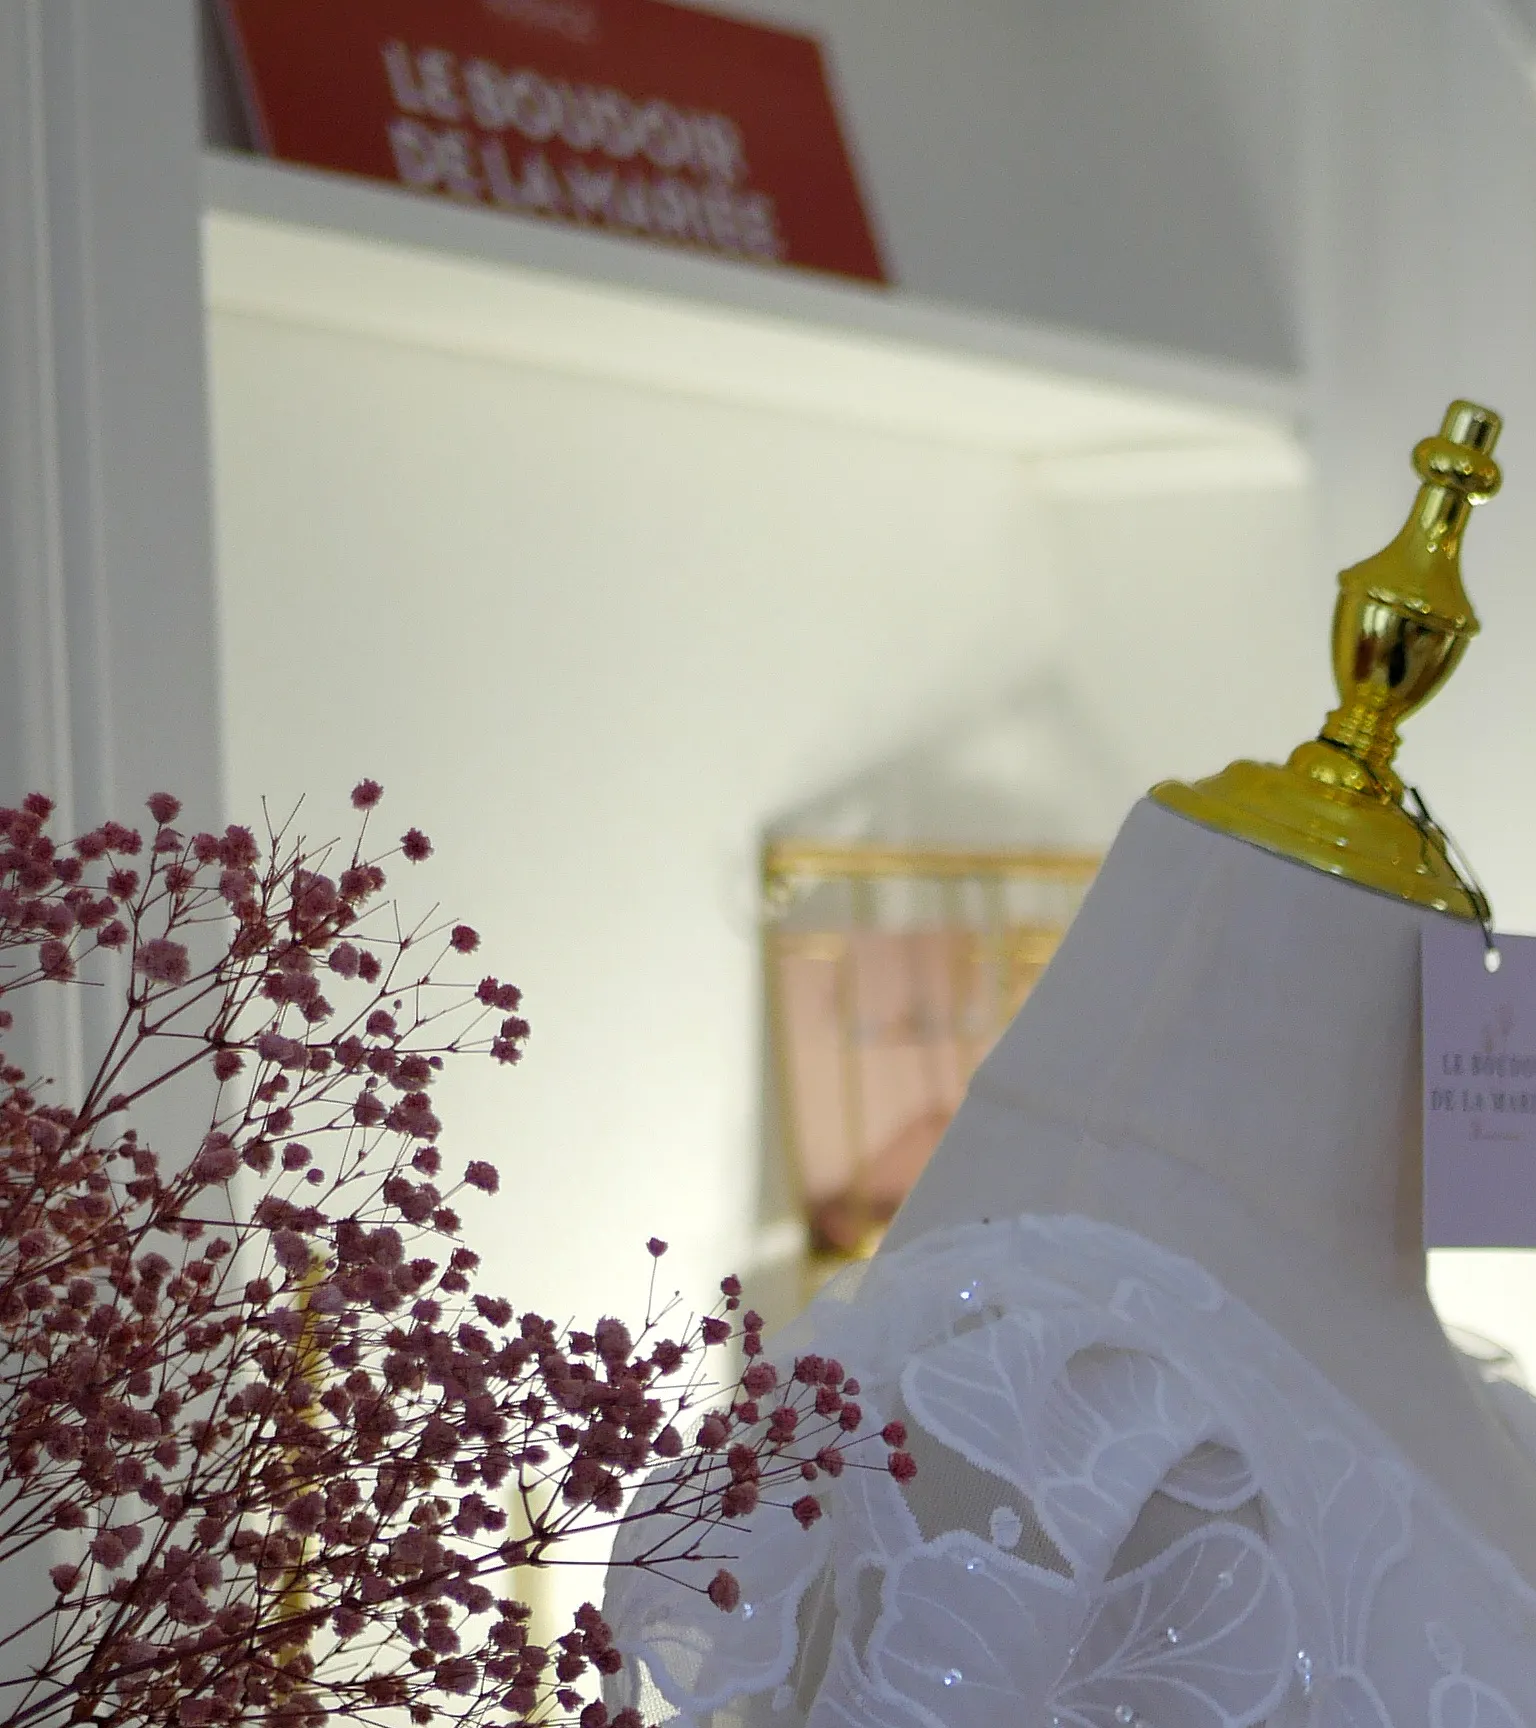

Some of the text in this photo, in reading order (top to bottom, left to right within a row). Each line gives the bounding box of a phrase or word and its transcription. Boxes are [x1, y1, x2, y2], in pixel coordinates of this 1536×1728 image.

[380, 37, 462, 120] LE
[1442, 1053, 1463, 1076] LE
[1431, 1089, 1454, 1111] DE
[1462, 1089, 1484, 1112] LA
